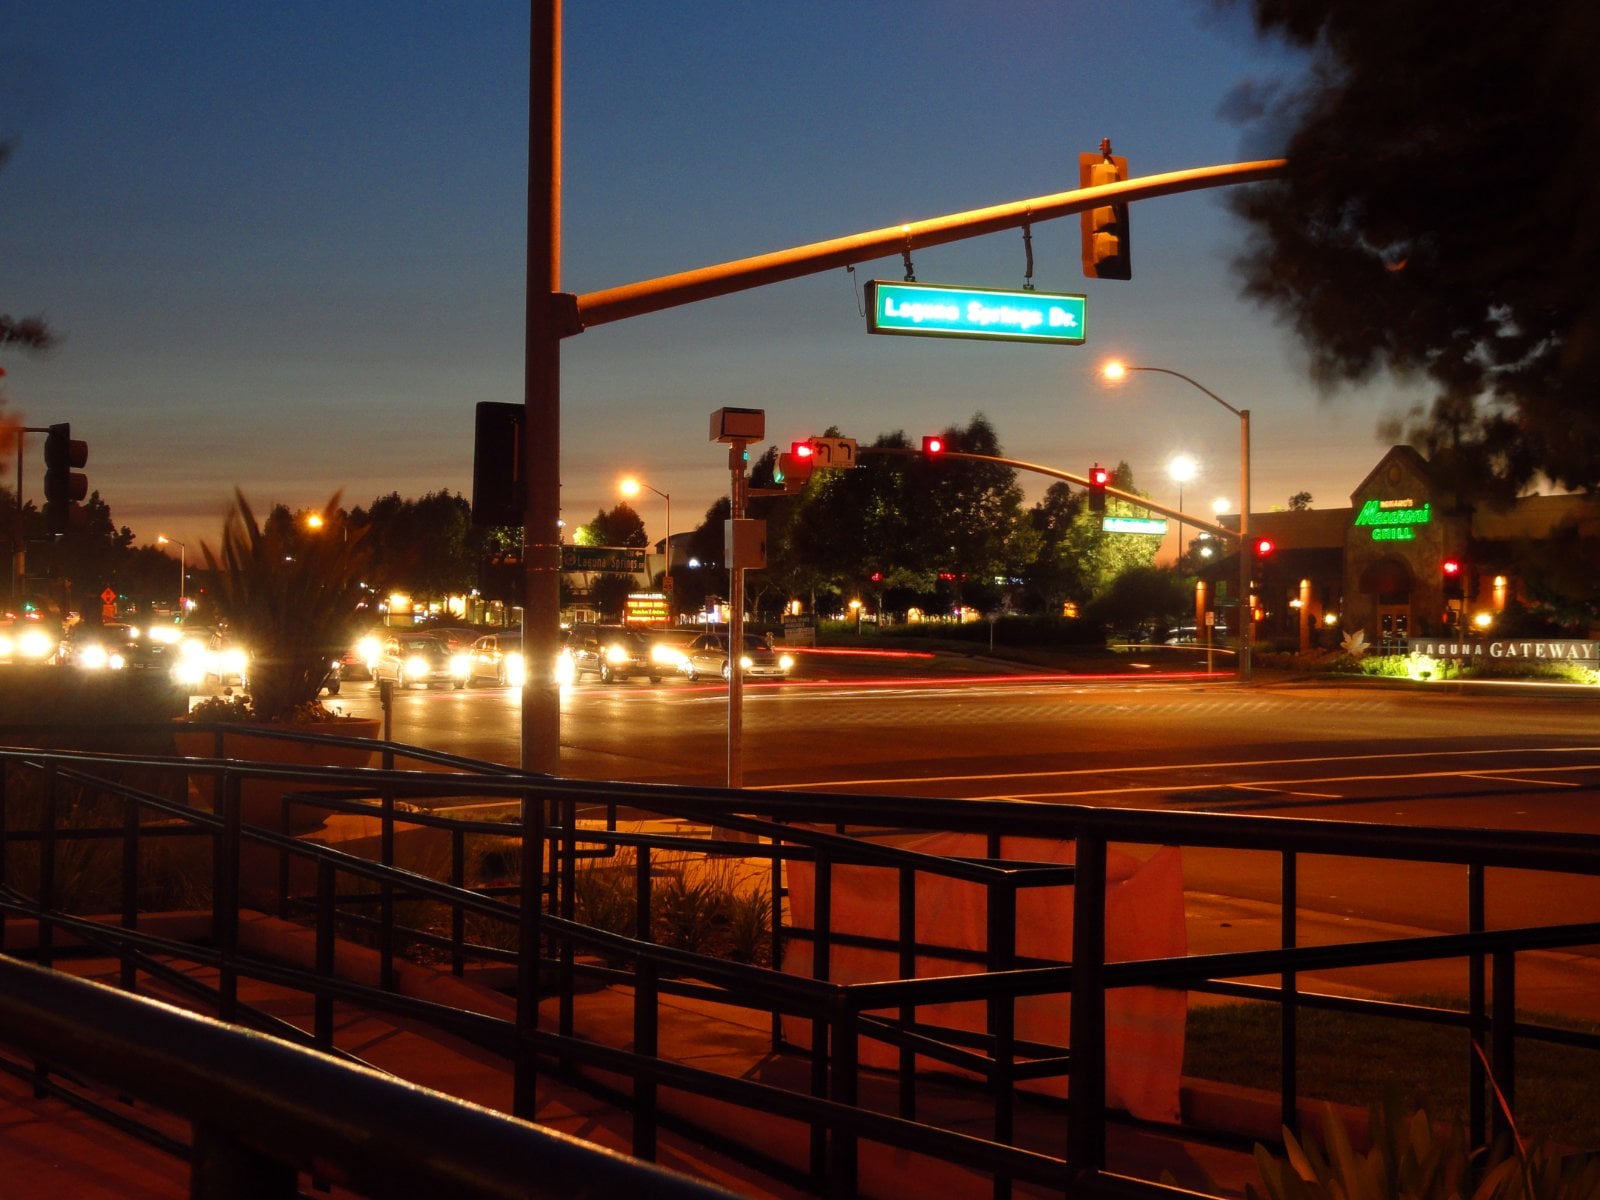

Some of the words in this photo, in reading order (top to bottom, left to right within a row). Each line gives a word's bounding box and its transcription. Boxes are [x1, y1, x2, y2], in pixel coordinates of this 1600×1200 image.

[885, 297, 960, 323] Laguna
[967, 301, 1043, 329] Springs
[1049, 306, 1079, 327] Dr.
[1372, 527, 1414, 540] GRILL
[577, 554, 607, 569] Laguna
[611, 556, 637, 572] Springs
[1415, 643, 1483, 655] LAGUNA
[1489, 642, 1593, 659] GATEWAY
